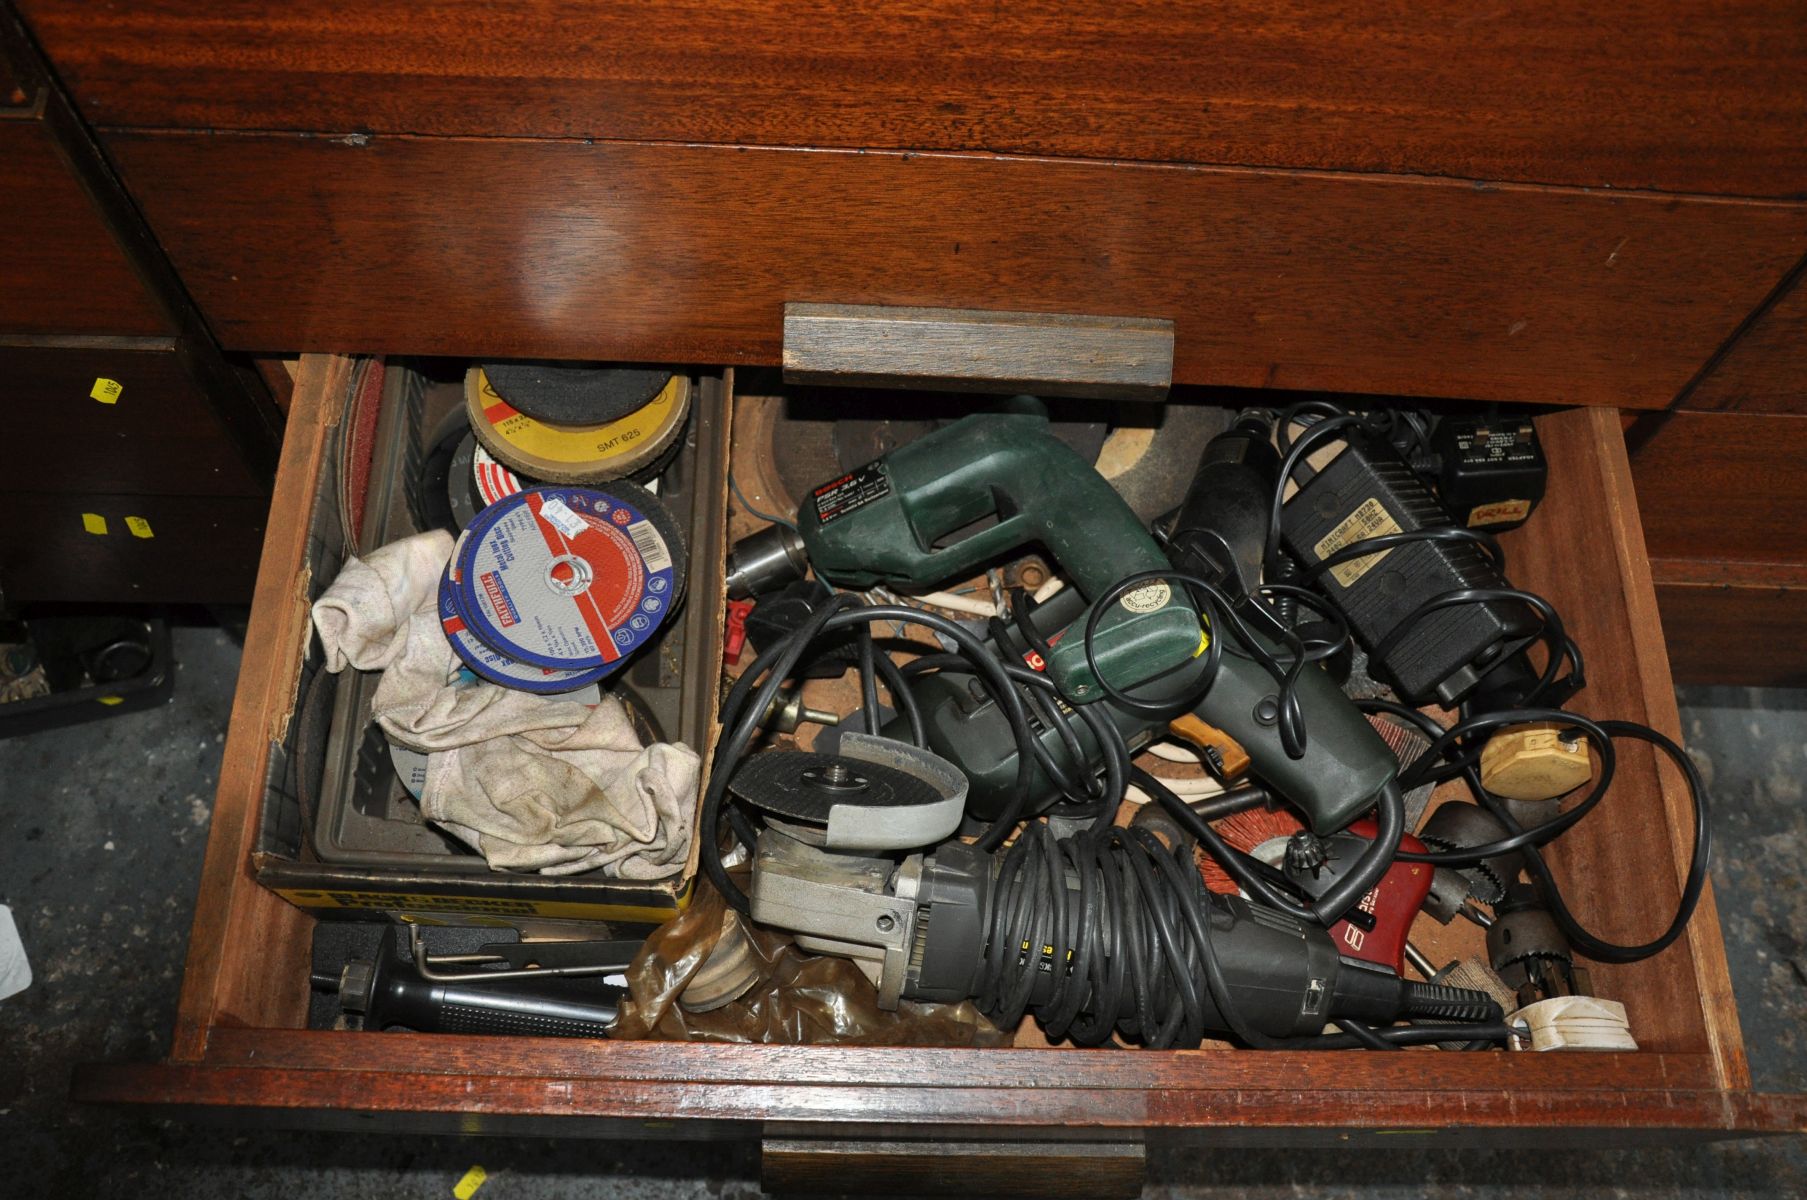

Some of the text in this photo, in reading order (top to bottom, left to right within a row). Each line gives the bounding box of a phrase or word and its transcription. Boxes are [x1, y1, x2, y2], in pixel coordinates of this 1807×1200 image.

[597, 428, 640, 452] SMT 625
[494, 526, 514, 561] Cutting Disc
[1320, 520, 1352, 550] MINICRAFT
[486, 574, 512, 625] FAITHFULL
